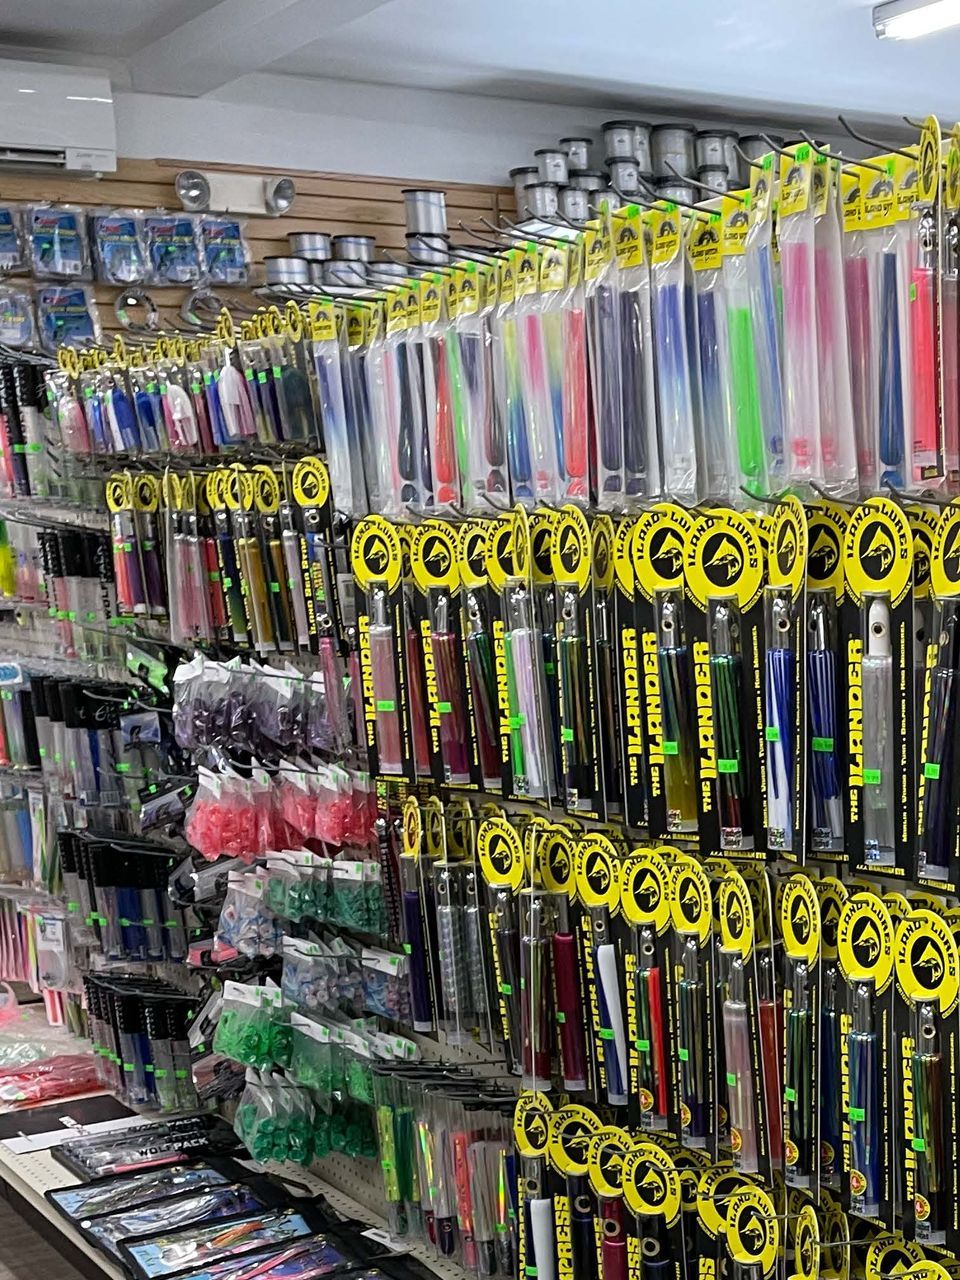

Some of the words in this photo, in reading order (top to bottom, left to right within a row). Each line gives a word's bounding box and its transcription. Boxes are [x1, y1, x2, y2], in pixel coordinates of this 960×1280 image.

[687, 518, 714, 568] ILAND
[726, 517, 758, 568] LURES
[358, 616, 376, 720] ILANDER
[622, 628, 642, 754] ILANDER
[897, 920, 921, 963] ILAND
[929, 917, 956, 977] LURES
